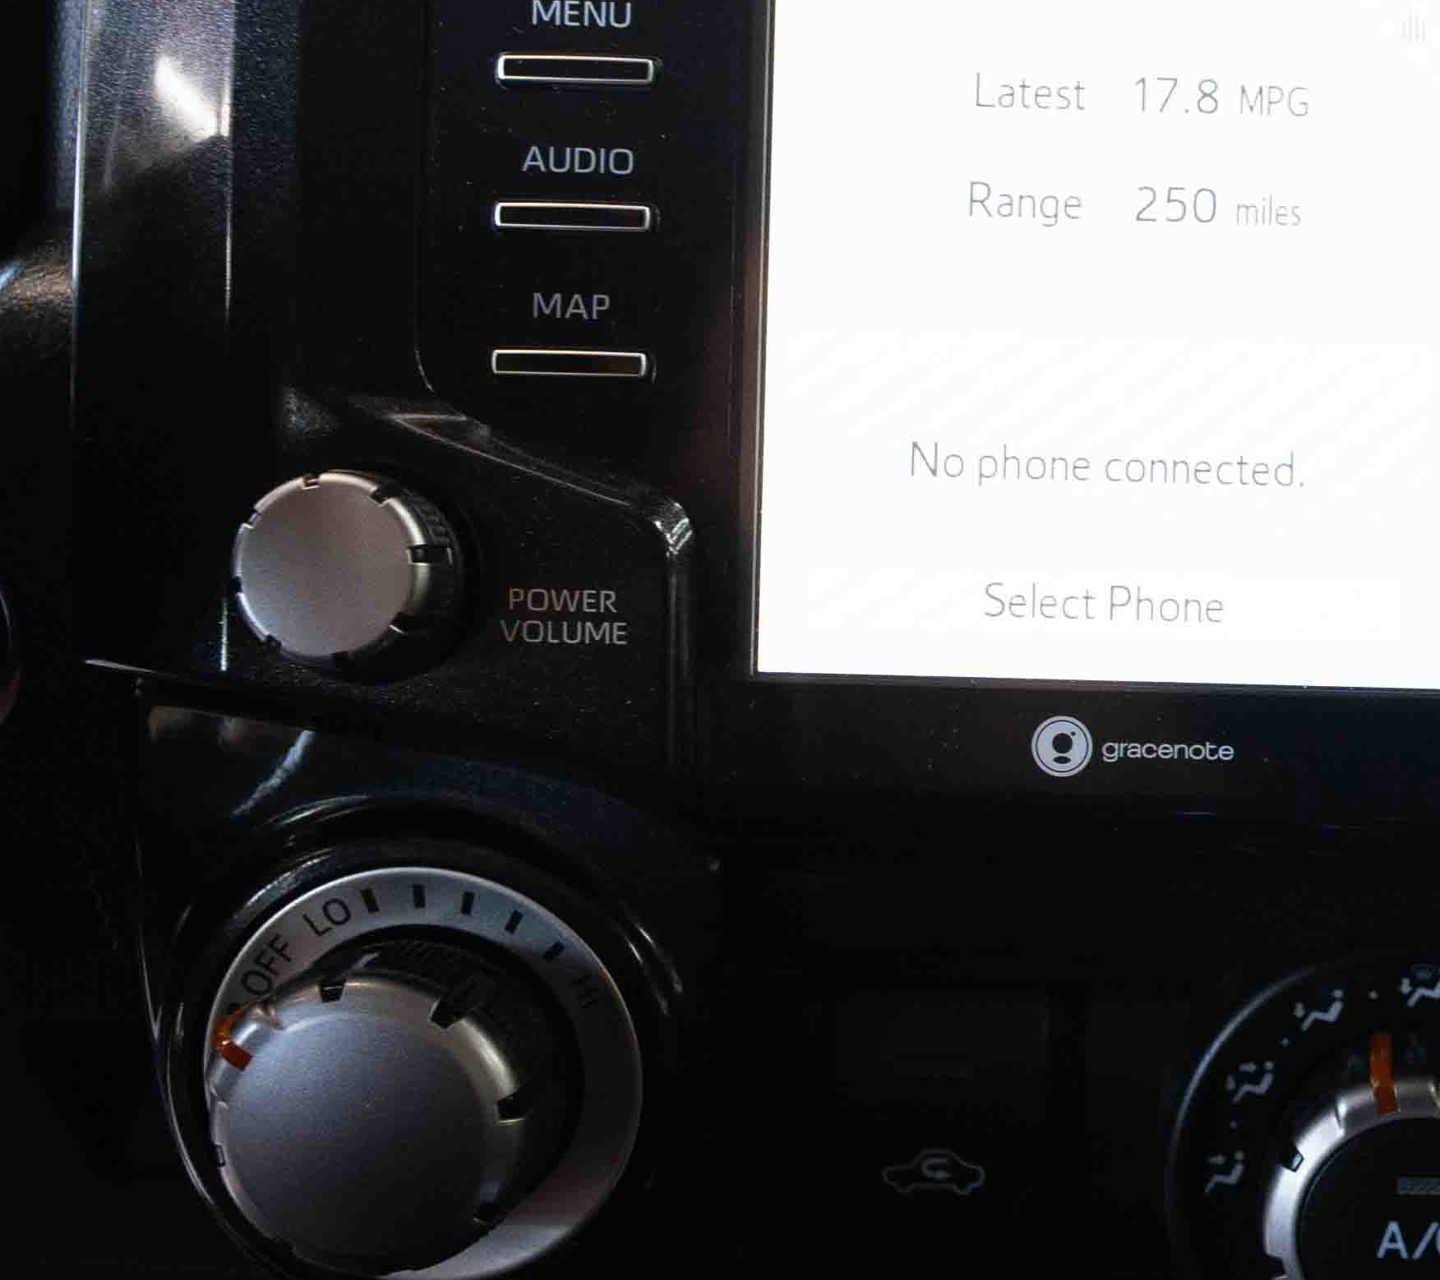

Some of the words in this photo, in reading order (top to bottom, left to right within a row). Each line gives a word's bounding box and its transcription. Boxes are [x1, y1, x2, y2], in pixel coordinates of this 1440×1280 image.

[531, 0, 632, 28] MENU
[974, 72, 1086, 112] Latest
[1133, 77, 1220, 116] 17.8
[1238, 84, 1309, 118] MPG
[522, 146, 634, 175] AUDIO
[968, 181, 1083, 226] Range
[1136, 186, 1217, 225] 250
[1235, 196, 1301, 228] miles
[532, 292, 610, 320] MAP
[910, 441, 964, 479] No
[978, 446, 1090, 487] phone
[1105, 452, 1305, 488] connected.
[508, 588, 617, 614] POWER
[985, 582, 1095, 619] Select
[1109, 585, 1224, 623] Phone
[501, 620, 628, 645] VOLUME
[1102, 738, 1235, 767] gracenote
[302, 896, 352, 938] LO
[241, 937, 292, 995] OFF
